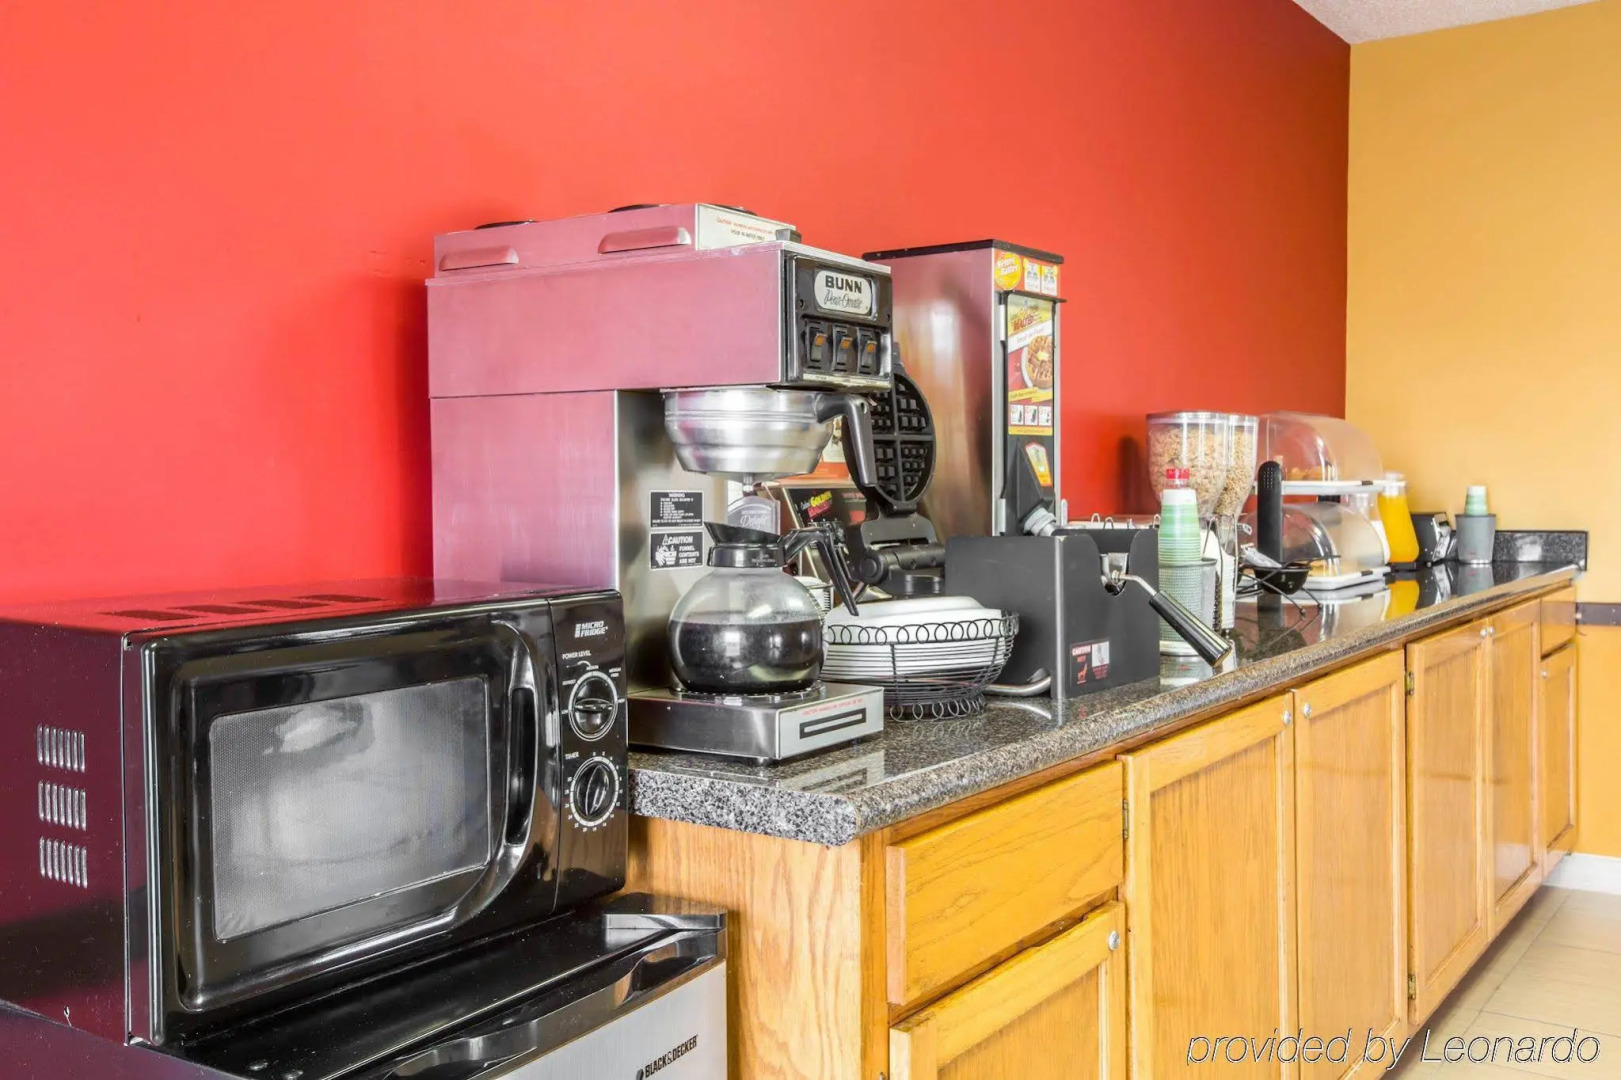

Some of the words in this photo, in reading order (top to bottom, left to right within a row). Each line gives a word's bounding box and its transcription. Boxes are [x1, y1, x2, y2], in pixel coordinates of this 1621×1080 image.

[825, 275, 862, 294] BUNN
[668, 535, 693, 545] CAUTION
[581, 621, 604, 630] MICRO
[581, 627, 606, 637] FRIDGE
[565, 751, 580, 760] TIMER
